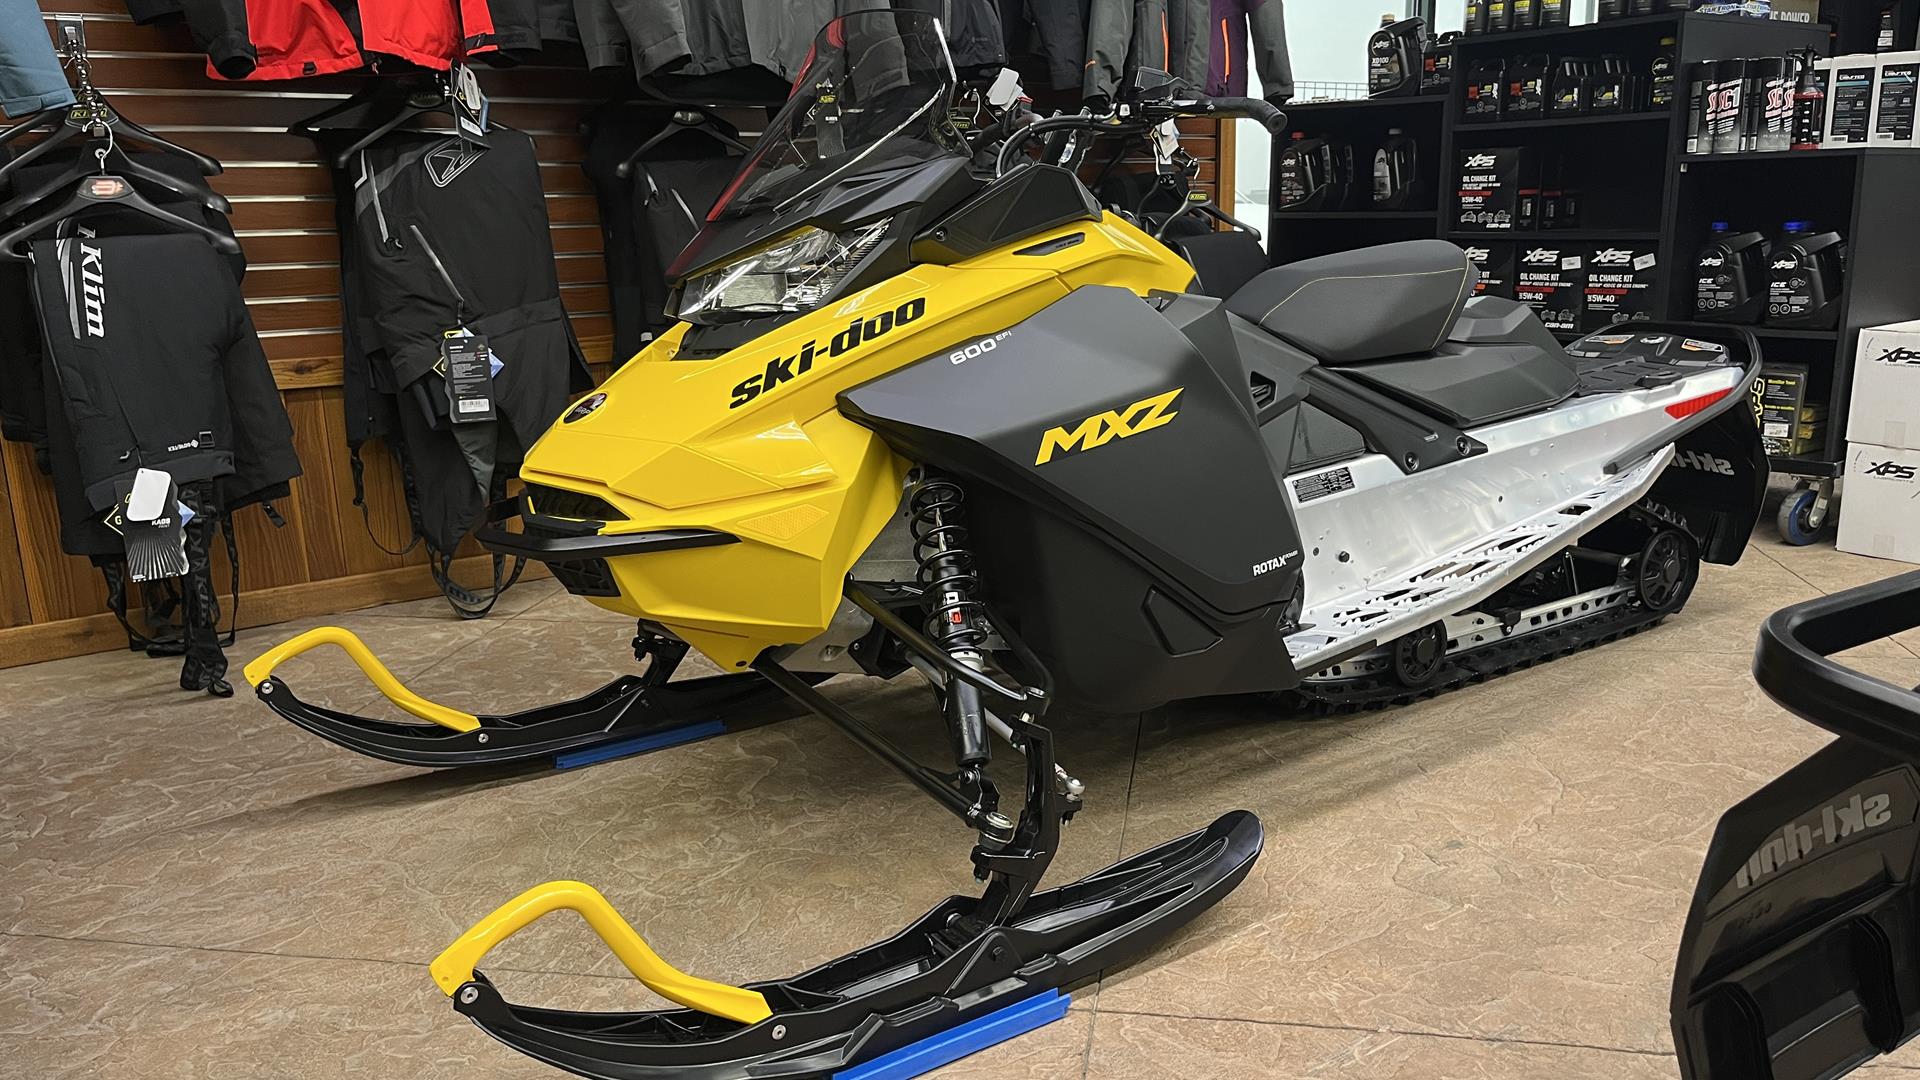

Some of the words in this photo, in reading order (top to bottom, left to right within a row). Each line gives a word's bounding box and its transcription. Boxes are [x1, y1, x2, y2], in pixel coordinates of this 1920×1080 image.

[1464, 154, 1497, 167] XPS
[1522, 248, 1560, 263] XPS
[1591, 248, 1634, 263] XPS
[1699, 257, 1723, 267] XPS
[1770, 259, 1798, 270] XPS
[1529, 273, 1550, 281] CHANGE
[1550, 273, 1560, 281] KIT
[1588, 274, 1598, 282] OIL
[1599, 274, 1623, 282] CHANGE
[1623, 274, 1634, 282] KIT
[81, 242, 106, 338] Klim
[1592, 294, 1615, 303] 5W-40
[729, 297, 925, 410] ski-doo
[949, 337, 997, 366] 600
[995, 330, 1012, 342] EFI
[1034, 386, 1185, 466] MXZ
[1863, 461, 1918, 479] XPS
[1252, 554, 1287, 577] ROTAX
